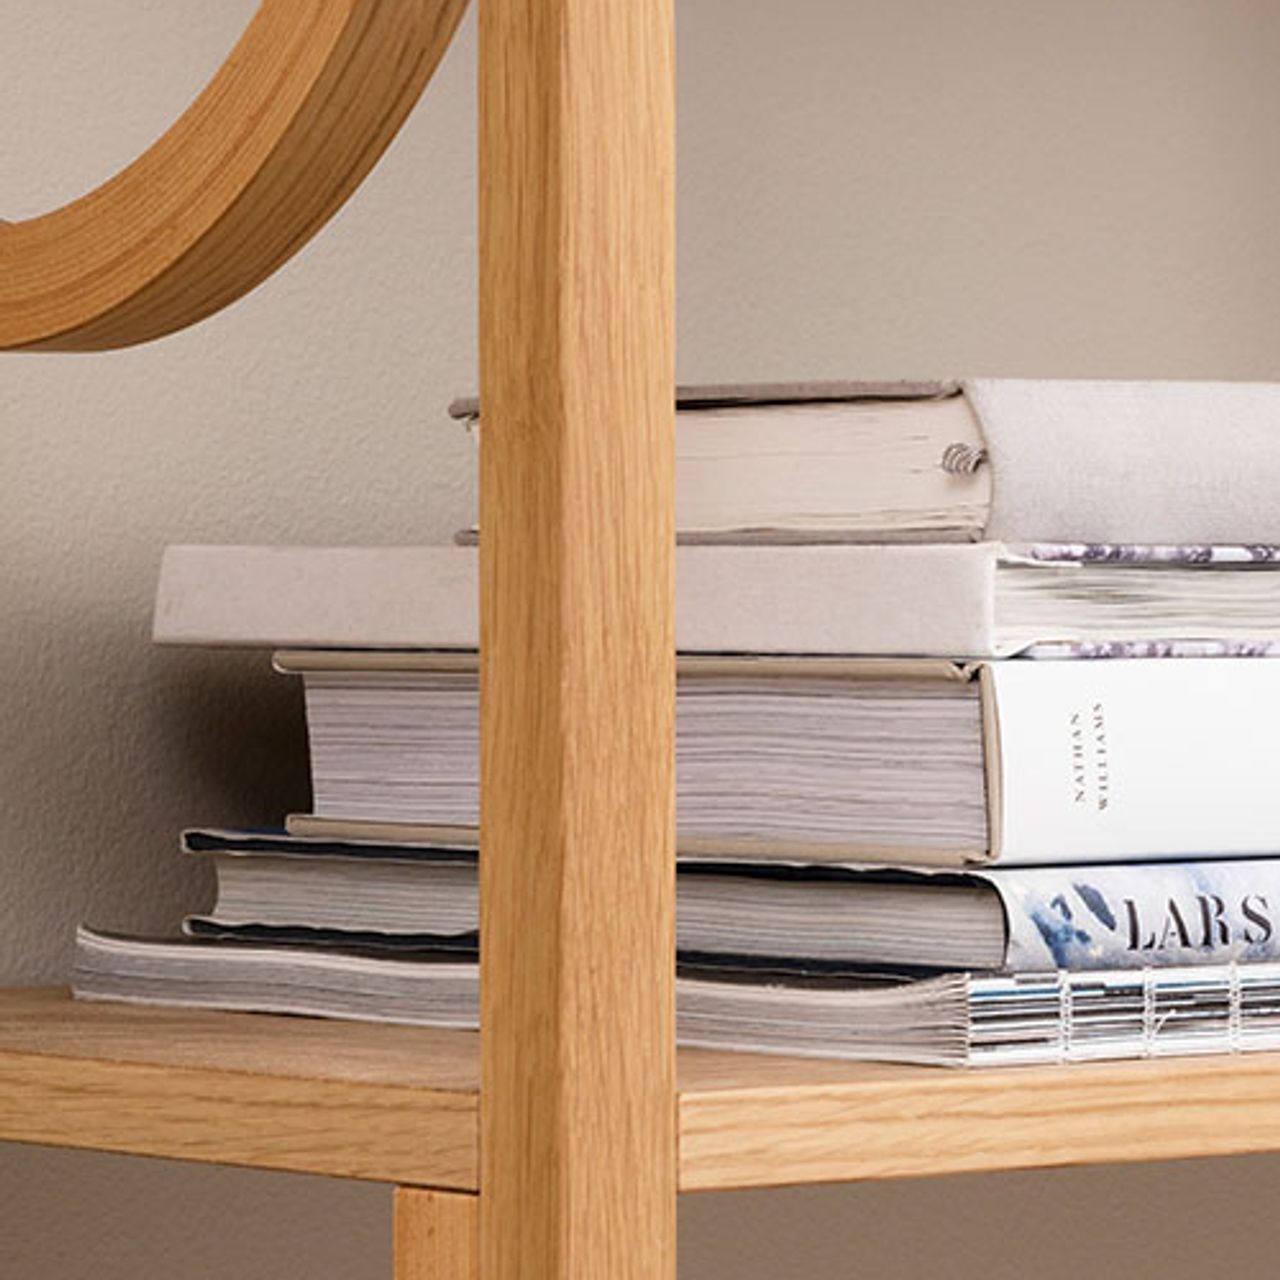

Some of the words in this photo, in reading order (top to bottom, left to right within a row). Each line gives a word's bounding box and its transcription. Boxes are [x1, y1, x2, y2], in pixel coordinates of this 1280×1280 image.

[1069, 712, 1086, 802] NATHAN
[1092, 702, 1108, 811] WILLIAMS
[1124, 892, 1273, 951] LARS
